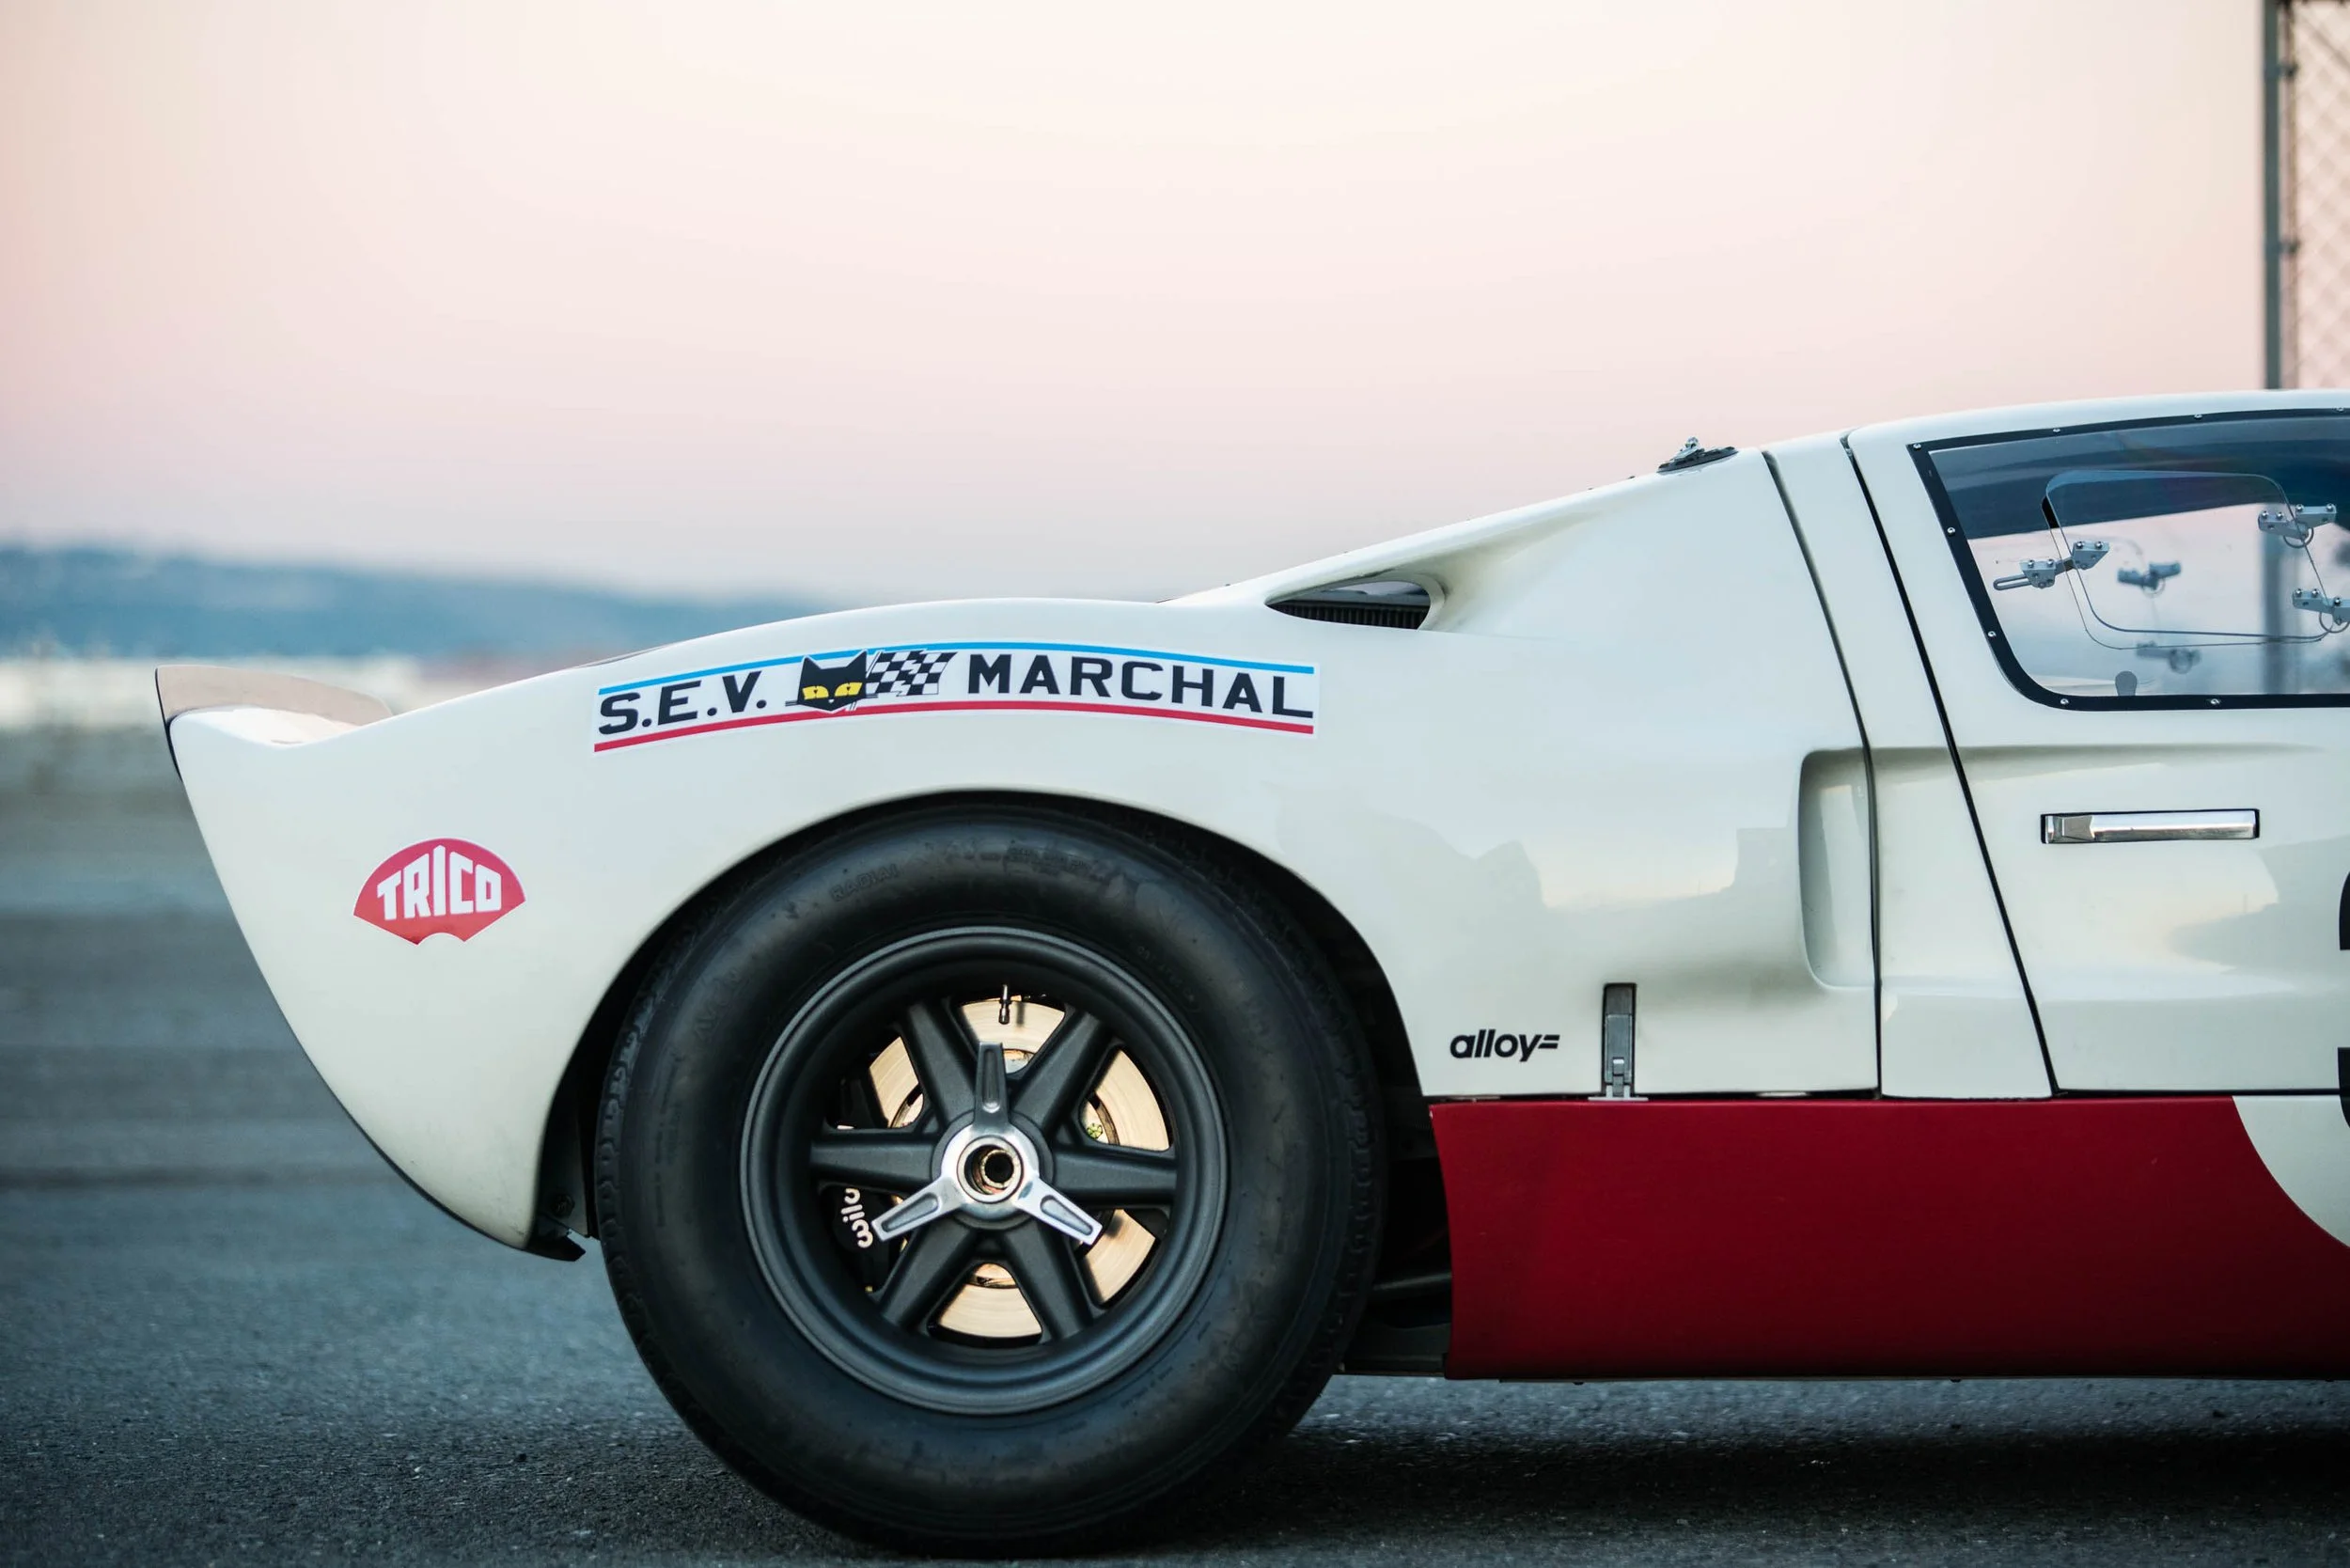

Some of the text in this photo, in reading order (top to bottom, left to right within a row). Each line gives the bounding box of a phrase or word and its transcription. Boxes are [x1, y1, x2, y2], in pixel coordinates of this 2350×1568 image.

[599, 654, 1314, 735] S.E.V. MARCHAL
[376, 844, 502, 921] TRICO
